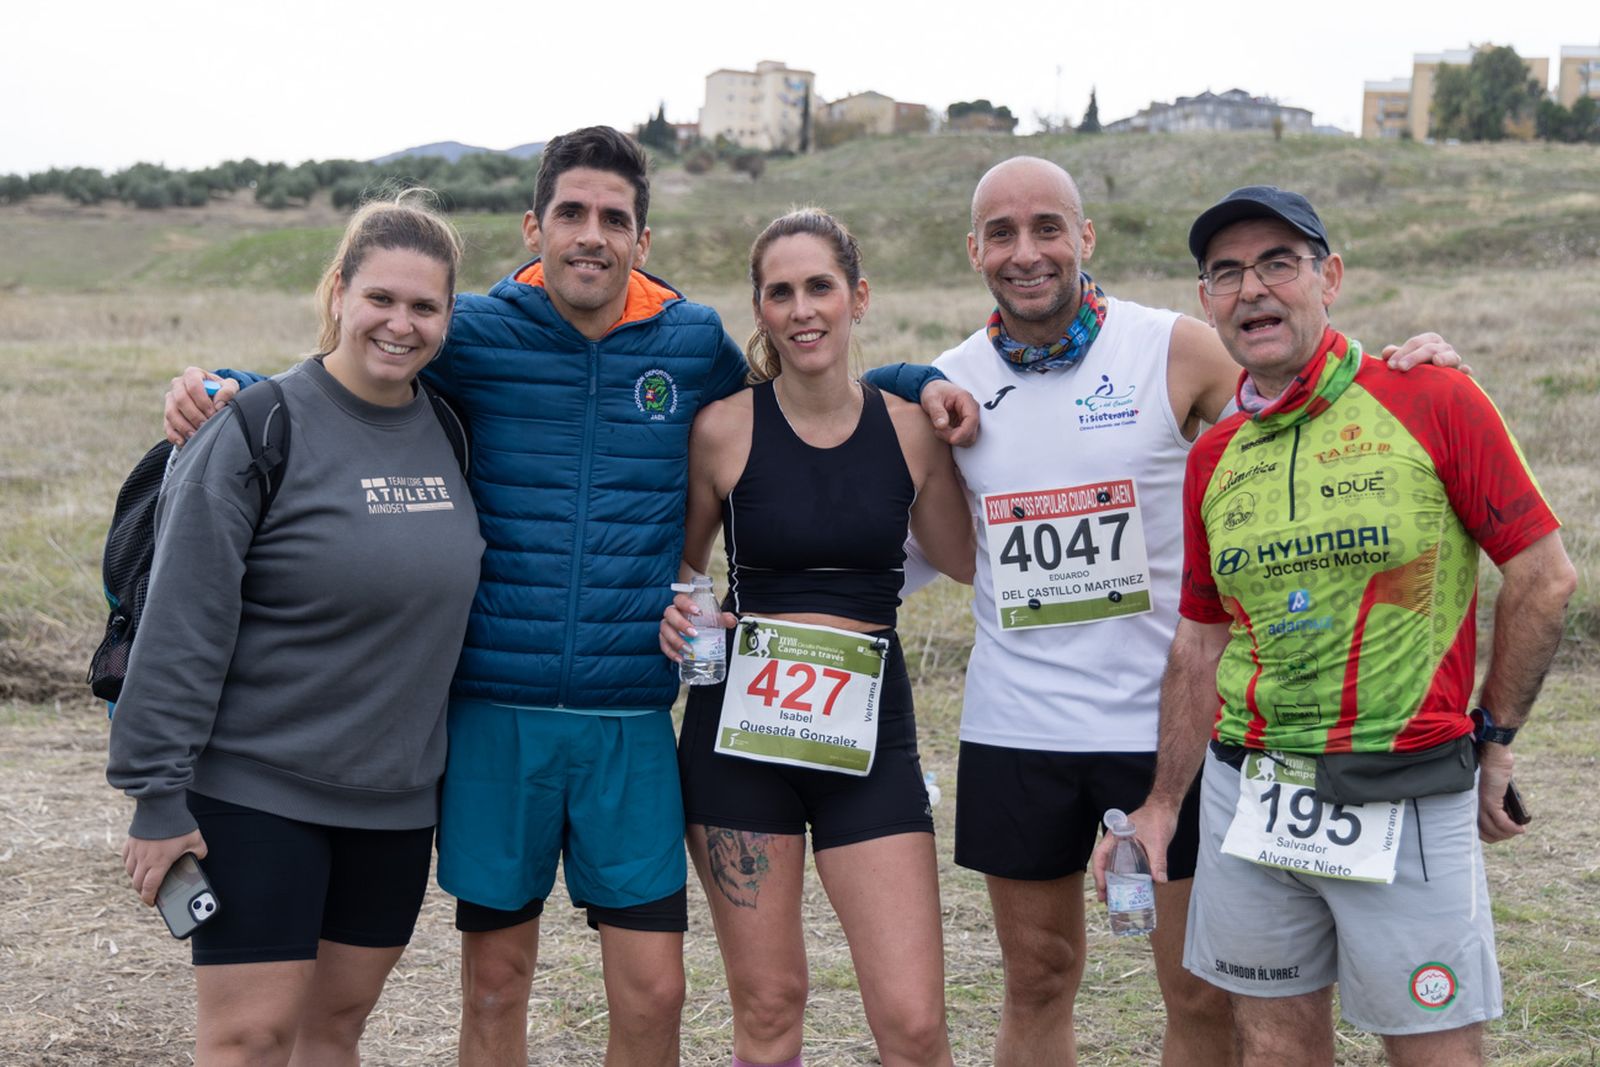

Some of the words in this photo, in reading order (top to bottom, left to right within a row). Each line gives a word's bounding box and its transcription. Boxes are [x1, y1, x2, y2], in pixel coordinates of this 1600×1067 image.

[388, 476, 406, 486] TEAM
[407, 478, 423, 486] CORE
[1338, 477, 1385, 496] DUE
[366, 487, 450, 502] ATHLETE
[1035, 494, 1067, 515] POPULAR
[1070, 490, 1097, 511] CIUDAD
[1110, 485, 1131, 505] JAEN
[368, 503, 406, 514] MINDSET
[1000, 512, 1130, 572] 4047
[1257, 526, 1390, 563] HYUNDAI
[1049, 570, 1090, 581] EDUARDO
[1263, 556, 1330, 579] Jacarsa
[1334, 550, 1391, 567] Motor
[1002, 590, 1025, 600] DEL
[1028, 583, 1082, 598] CASTILLO
[1085, 574, 1144, 593] MARTINEZ
[777, 646, 809, 658] Campo
[818, 651, 845, 662] través
[747, 660, 852, 716] 427
[864, 682, 877, 723] Veterana
[779, 710, 813, 723] Isabel
[739, 719, 796, 738] Quesada
[799, 728, 858, 748] Gonzalez
[1283, 768, 1316, 781] Campo
[1260, 783, 1362, 846] 195
[1383, 808, 1398, 852] Veterano
[1276, 836, 1328, 855] Salvador
[1257, 849, 1310, 870] Alvarez
[1313, 859, 1352, 877] Nieto
[1215, 959, 1257, 980] SALVADOR
[1258, 964, 1301, 981] ÁLVAREZ
